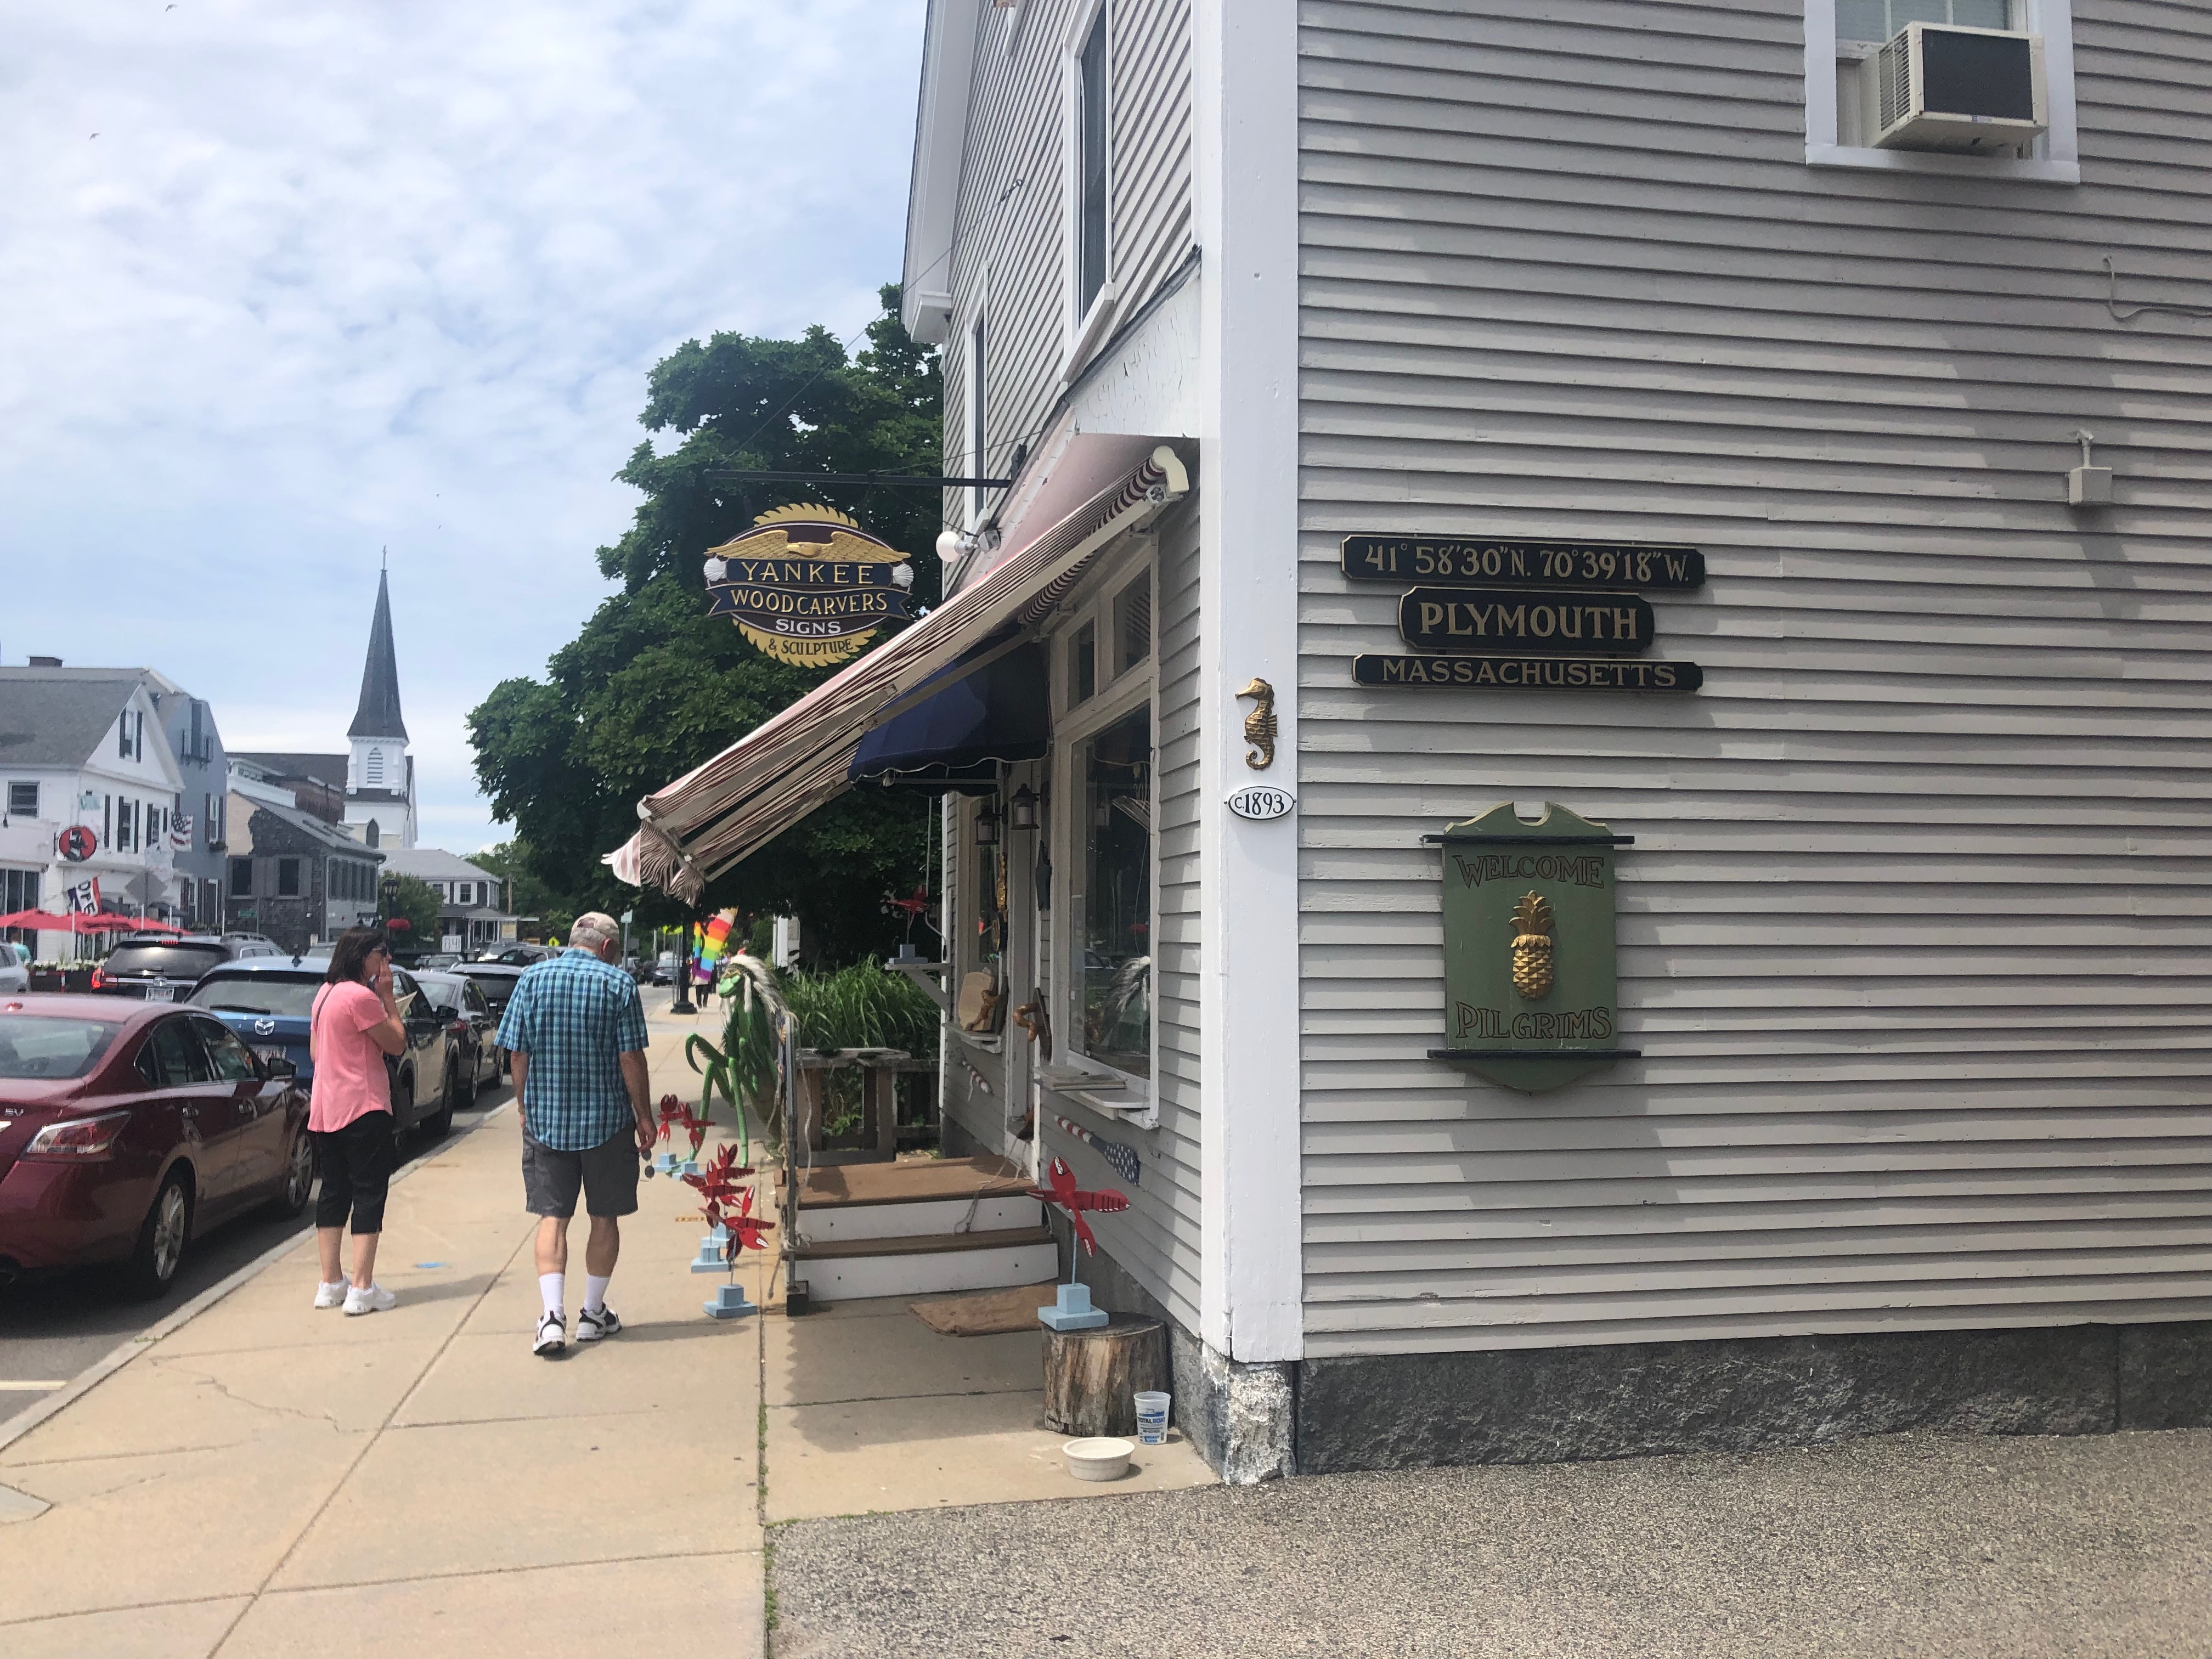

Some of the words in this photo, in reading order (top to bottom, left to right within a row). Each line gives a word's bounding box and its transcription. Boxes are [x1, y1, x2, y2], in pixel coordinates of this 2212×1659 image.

[741, 561, 874, 584] YANKEE
[729, 589, 888, 616] WOODCARVERS
[775, 618, 842, 635] SIGNS
[1419, 602, 1640, 641] PLYMOUTH
[768, 637, 777, 653] &
[781, 638, 854, 656] SCULPTURE
[1382, 659, 1677, 687] MASSACHUSETTS
[1452, 855, 1605, 889] WELCOME
[78, 879, 96, 915] OPE
[1455, 1001, 1612, 1040] PILGRIMS
[4, 1108, 24, 1117] SV
